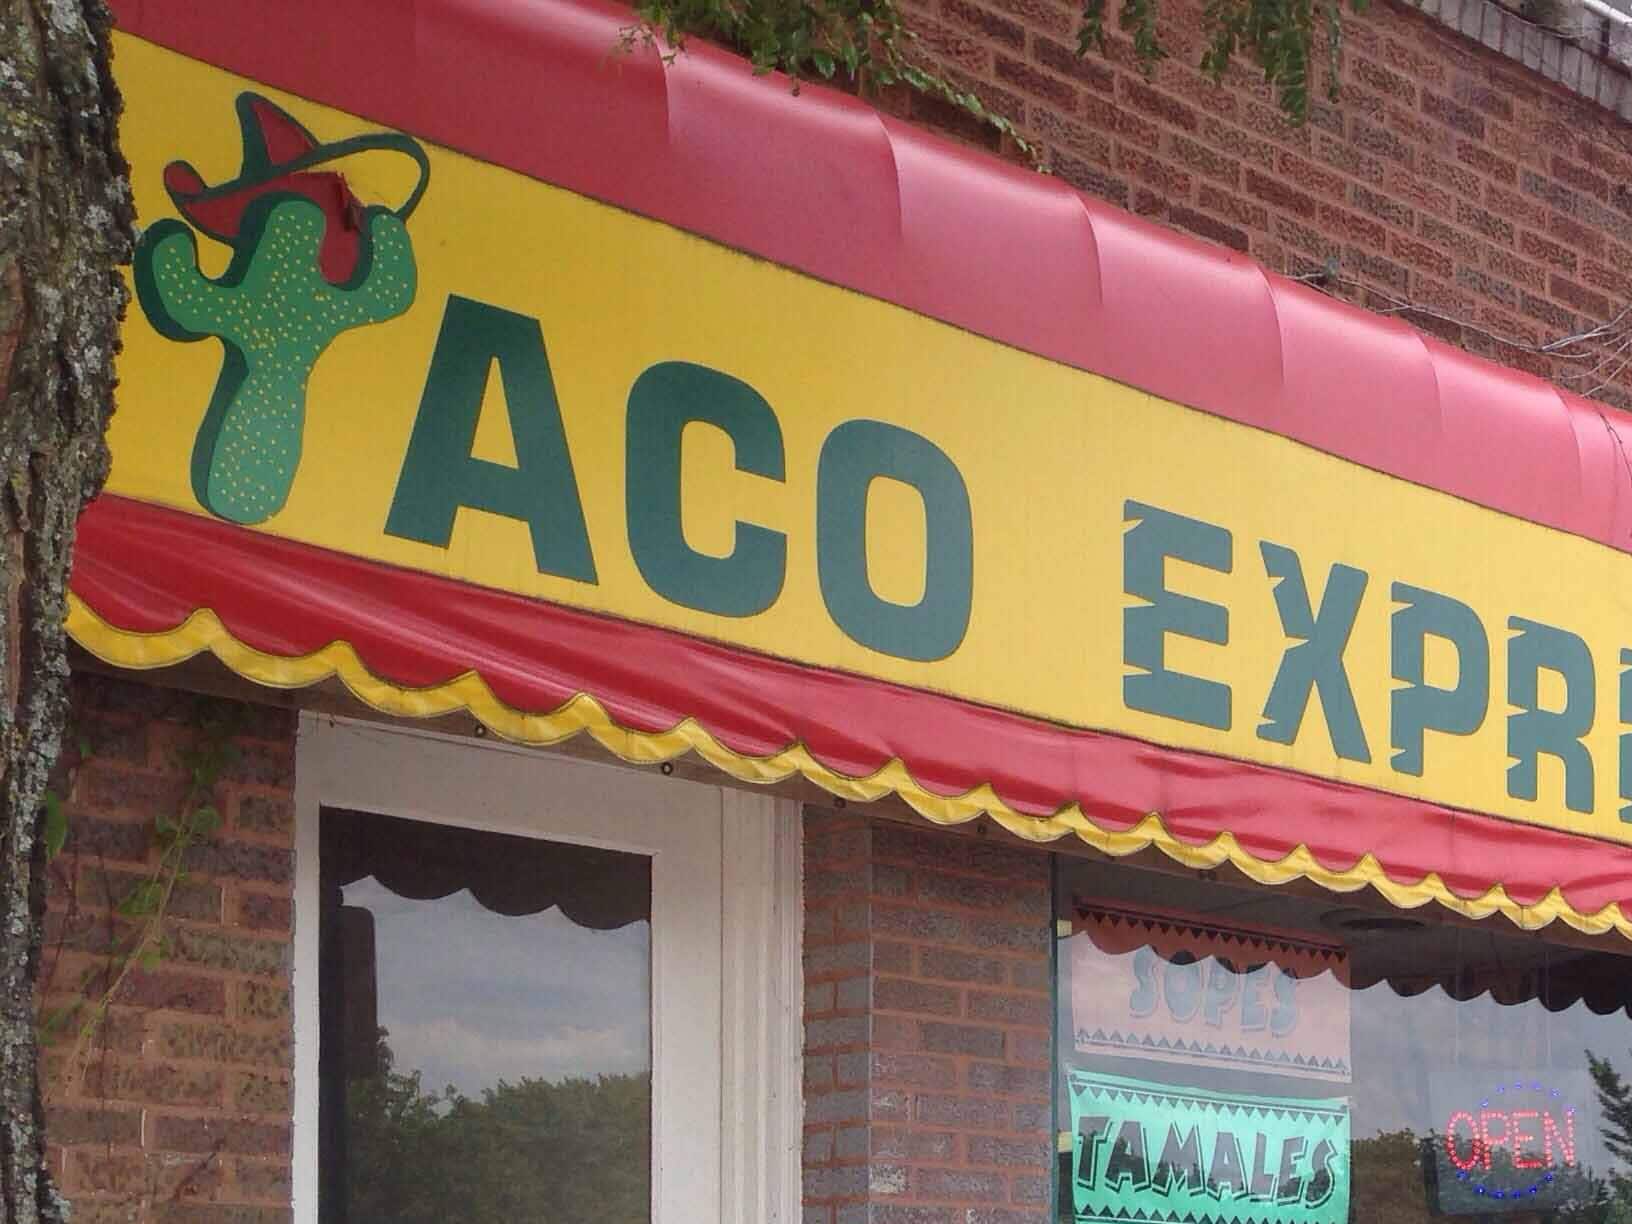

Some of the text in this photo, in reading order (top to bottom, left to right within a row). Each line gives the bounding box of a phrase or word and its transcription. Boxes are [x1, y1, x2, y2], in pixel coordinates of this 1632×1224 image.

[1129, 946, 1298, 1039] SOPES
[1077, 1116, 1337, 1210] TAMALES
[1446, 1110, 1576, 1170] OPEN
